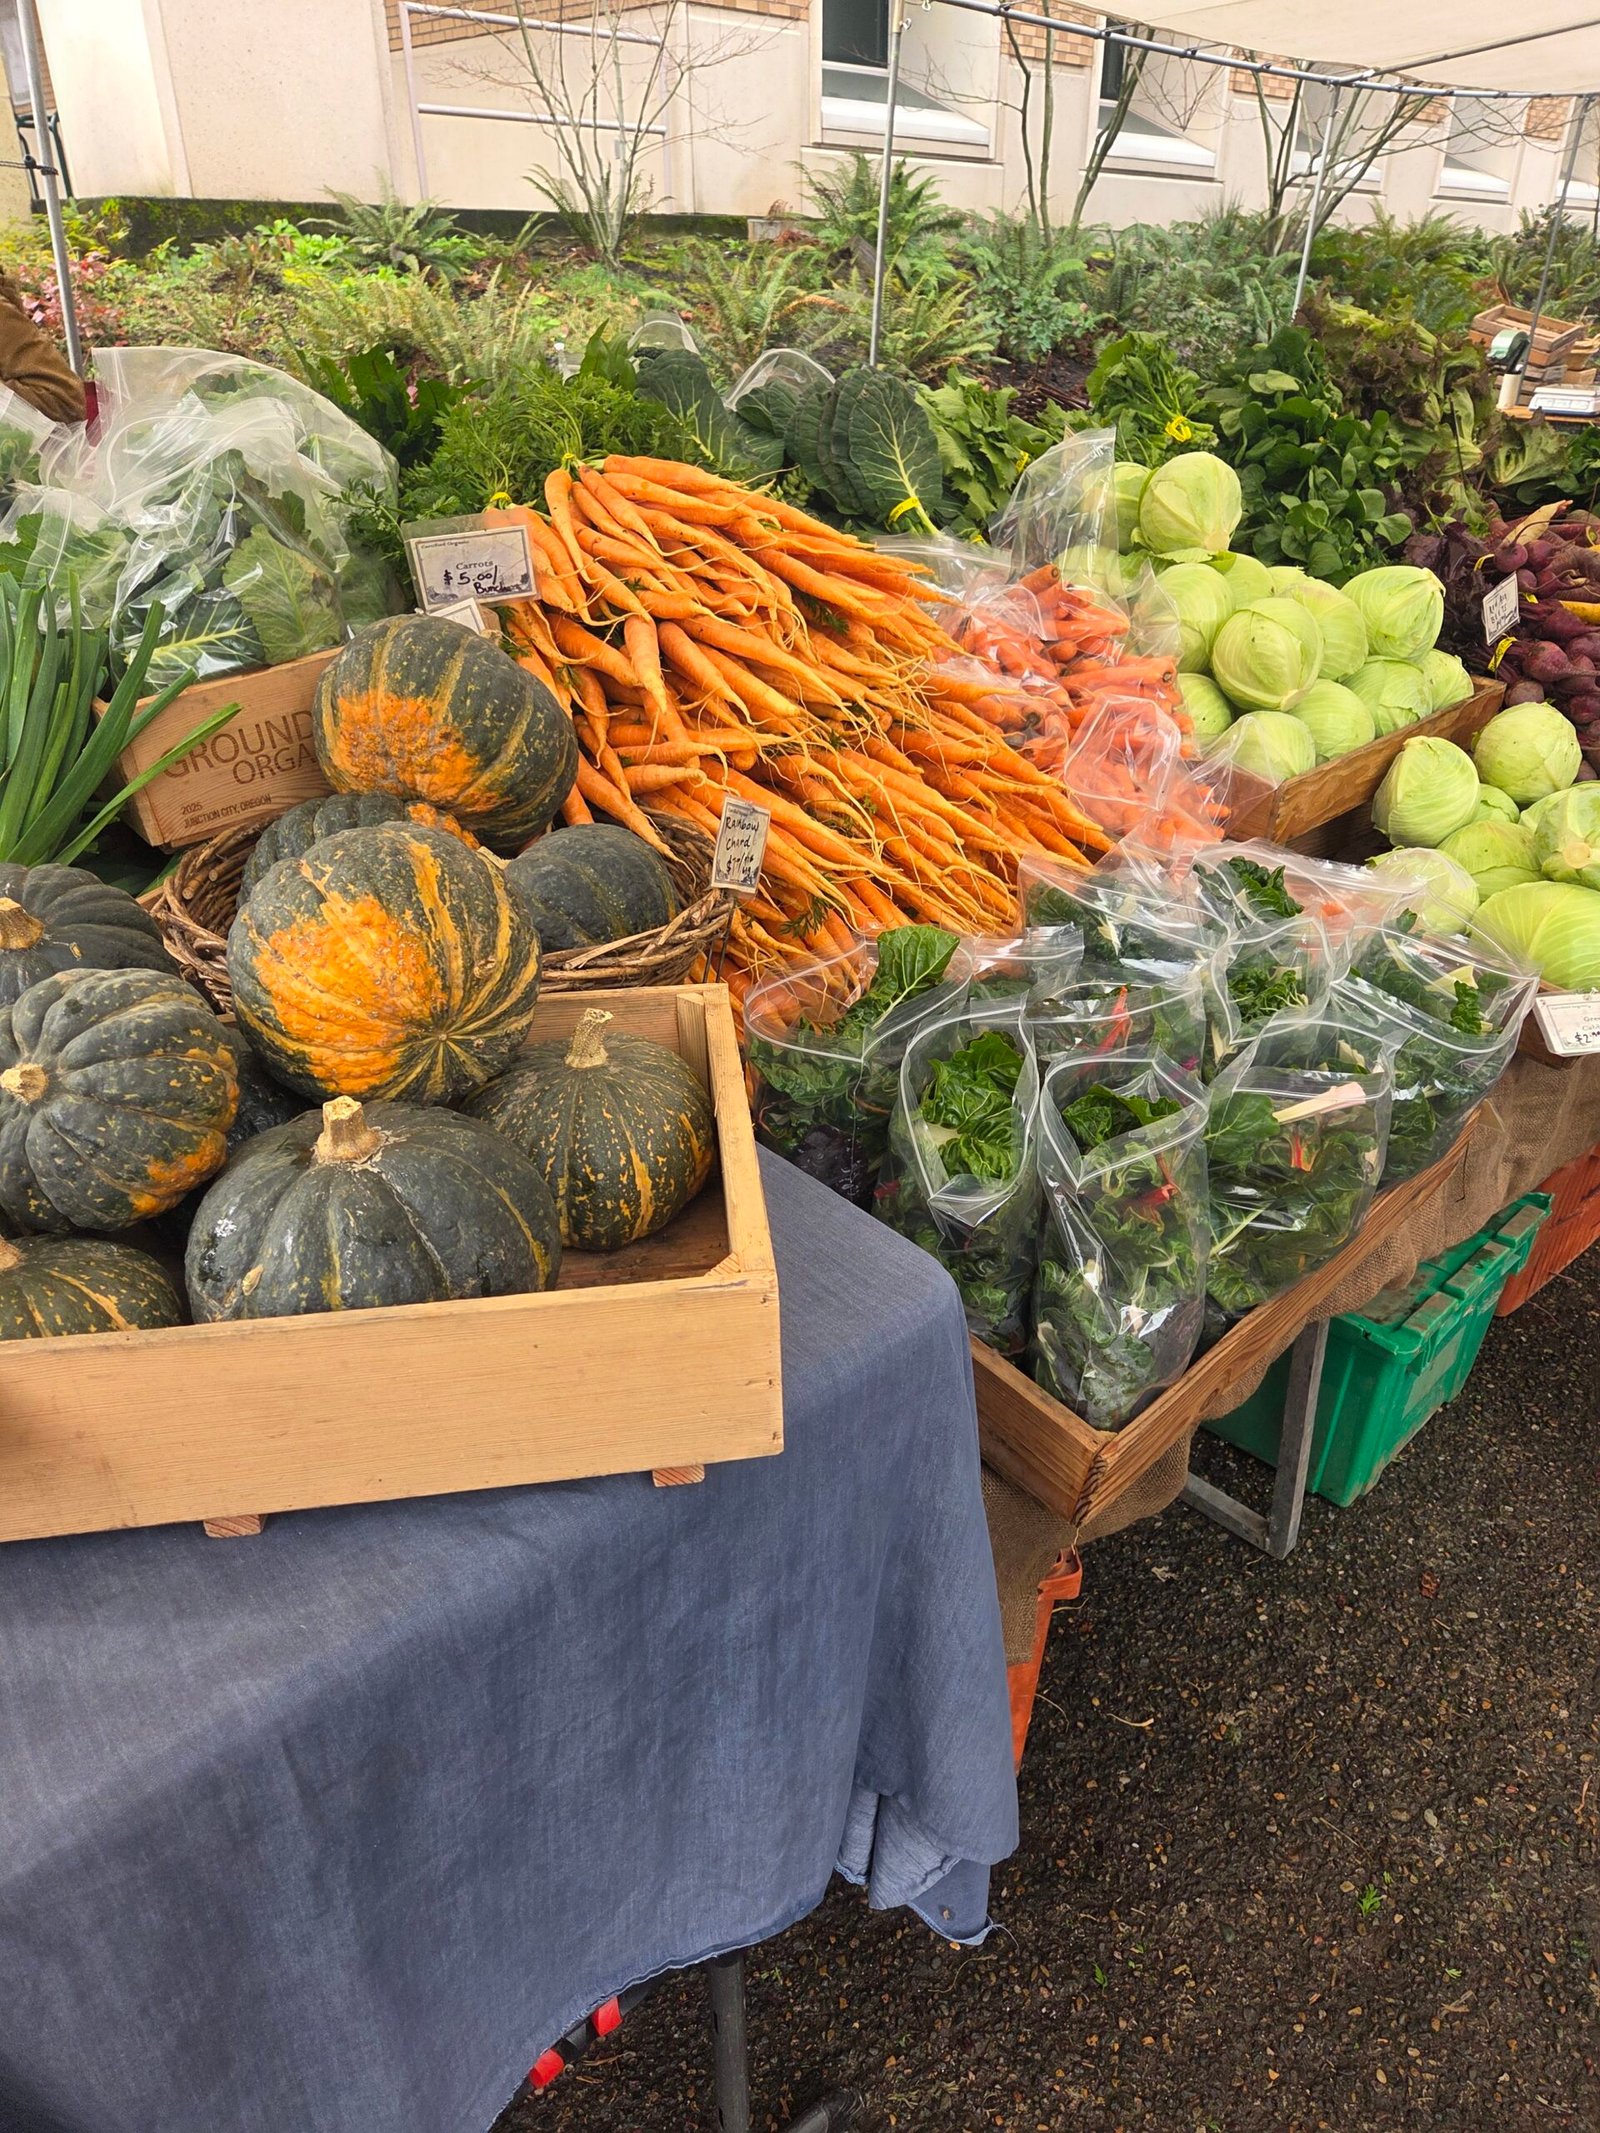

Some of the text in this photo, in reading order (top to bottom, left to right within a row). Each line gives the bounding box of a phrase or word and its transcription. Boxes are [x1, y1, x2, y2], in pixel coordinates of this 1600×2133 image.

[455, 560, 495, 571] Carrots
[184, 809, 221, 829] JUNCTION
[239, 793, 272, 812] OREGON
